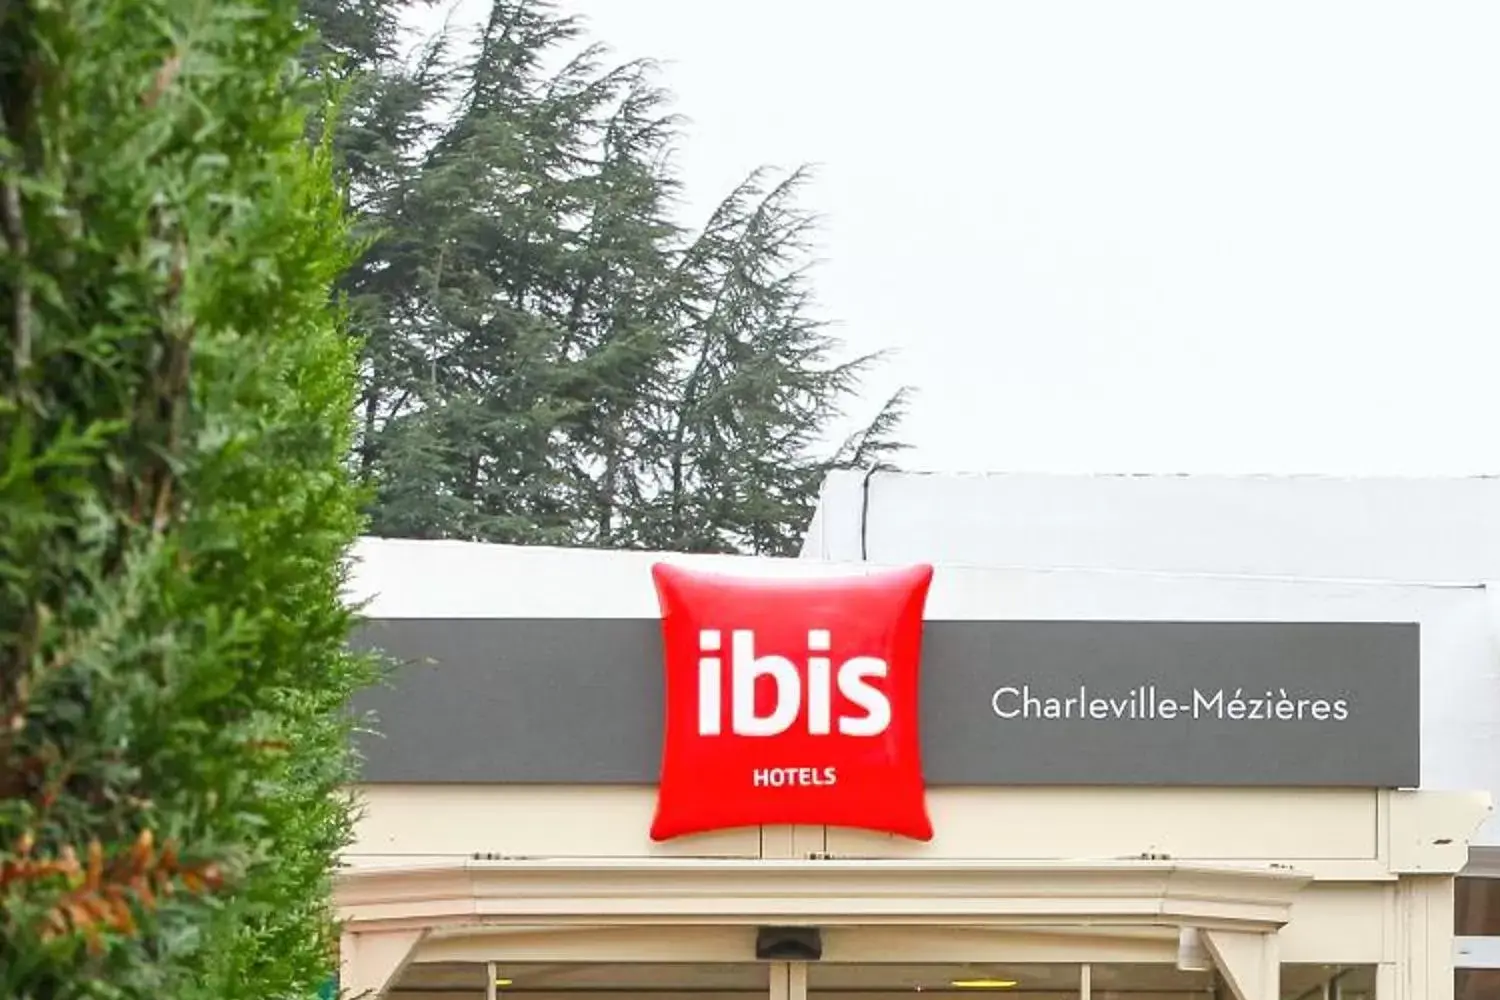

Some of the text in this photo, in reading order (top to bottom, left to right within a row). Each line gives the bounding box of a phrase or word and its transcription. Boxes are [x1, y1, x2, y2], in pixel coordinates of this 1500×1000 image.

[698, 629, 891, 736] ibis
[991, 685, 1349, 720] Charleville-Mézières
[753, 767, 837, 787] HOTELS
